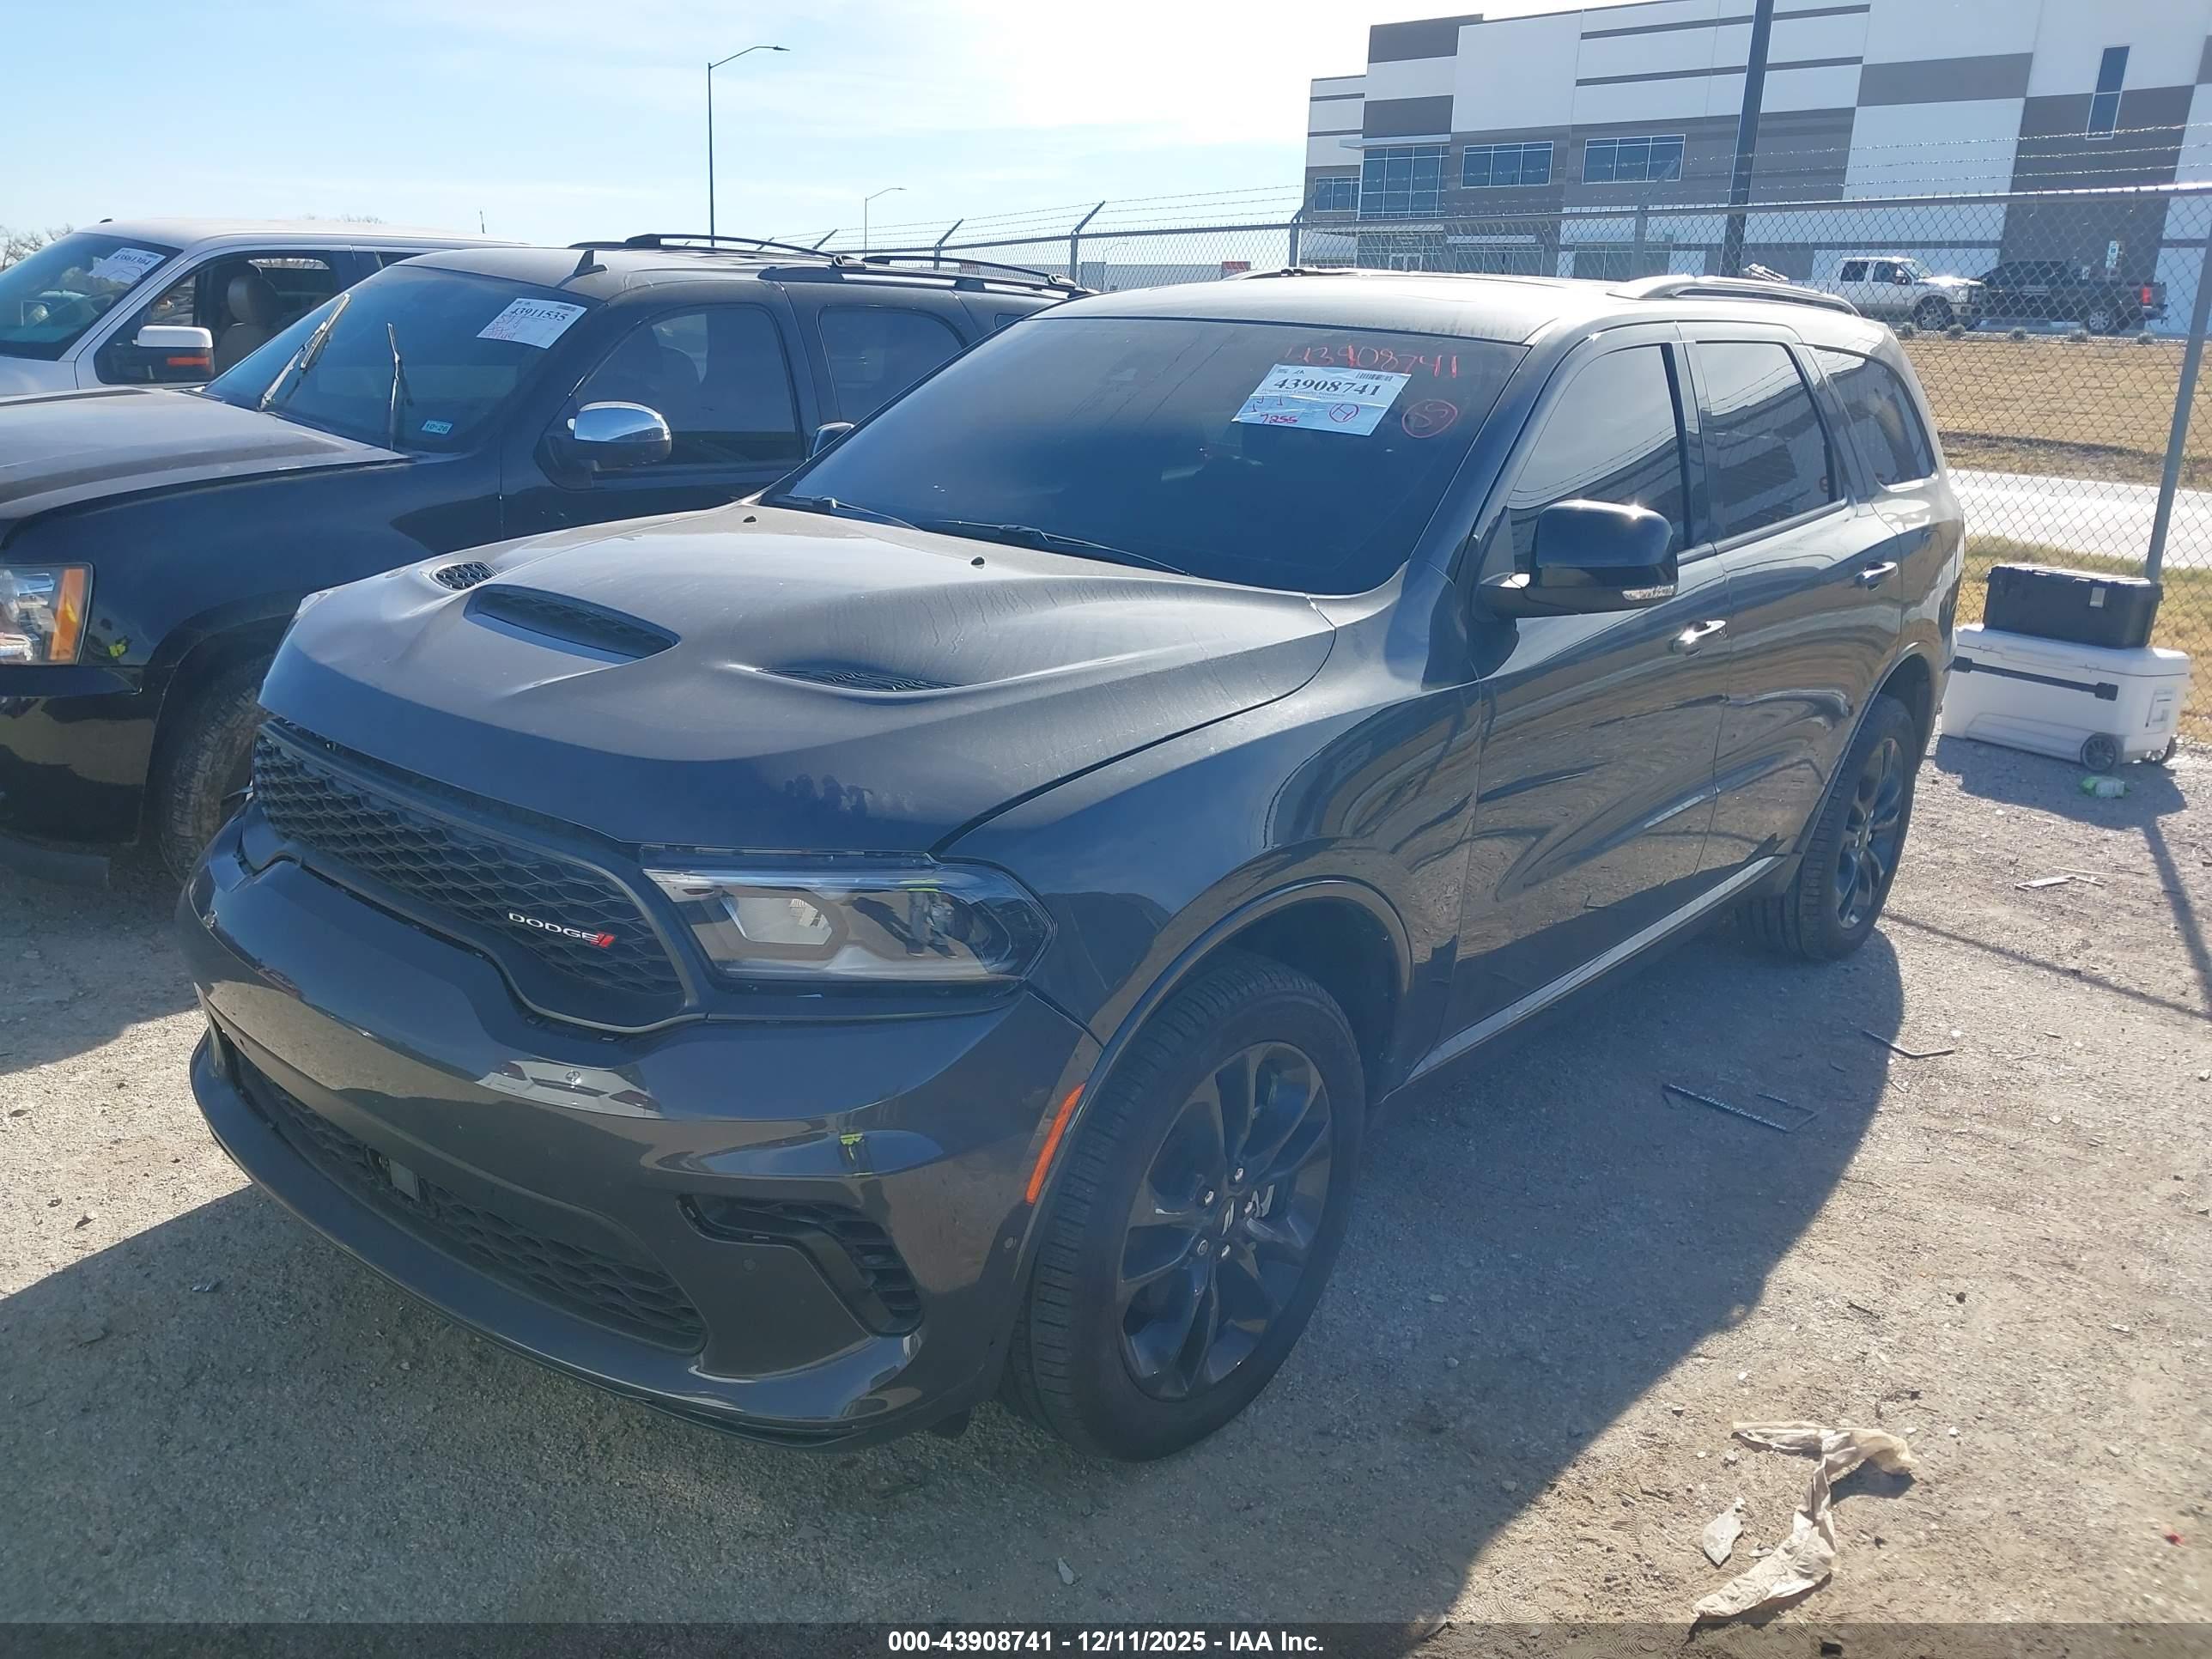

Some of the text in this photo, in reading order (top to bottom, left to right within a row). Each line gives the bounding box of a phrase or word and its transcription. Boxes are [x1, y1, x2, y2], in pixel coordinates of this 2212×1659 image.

[510, 307, 569, 322] 43911535
[1273, 377, 1382, 397] 43908741
[508, 912, 600, 944] DODGE
